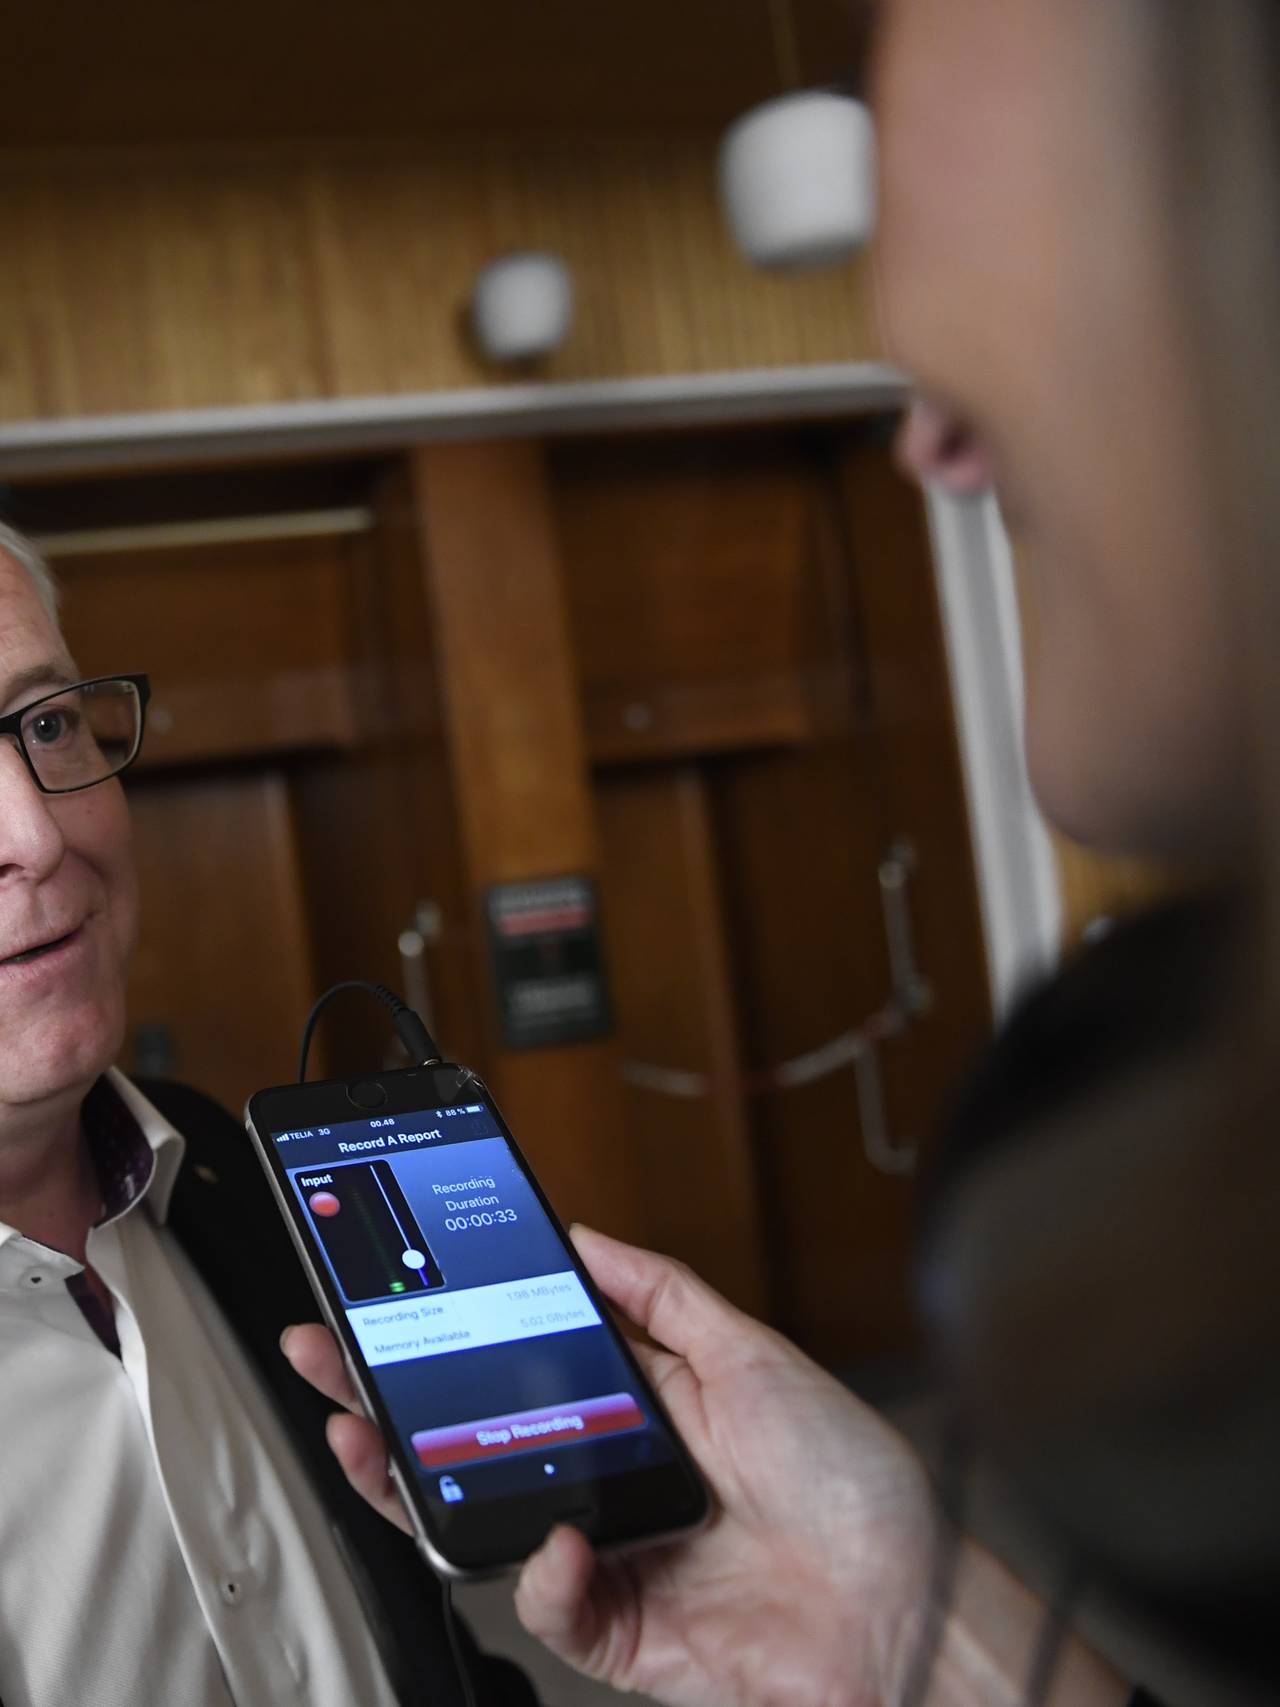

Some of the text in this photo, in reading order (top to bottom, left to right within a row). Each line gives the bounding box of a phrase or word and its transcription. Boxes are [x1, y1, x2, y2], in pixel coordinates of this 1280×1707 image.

[289, 1128, 331, 1141] TELIA 3G
[338, 1129, 442, 1153] Record A Report
[301, 1174, 333, 1187] Input
[432, 1176, 496, 1195] Recording
[445, 1194, 500, 1212] Duration
[445, 1209, 518, 1232] 00:00:33
[363, 1304, 444, 1327] Recording Size
[374, 1329, 471, 1354] Memory Available
[476, 1415, 585, 1446] Stop Recording
